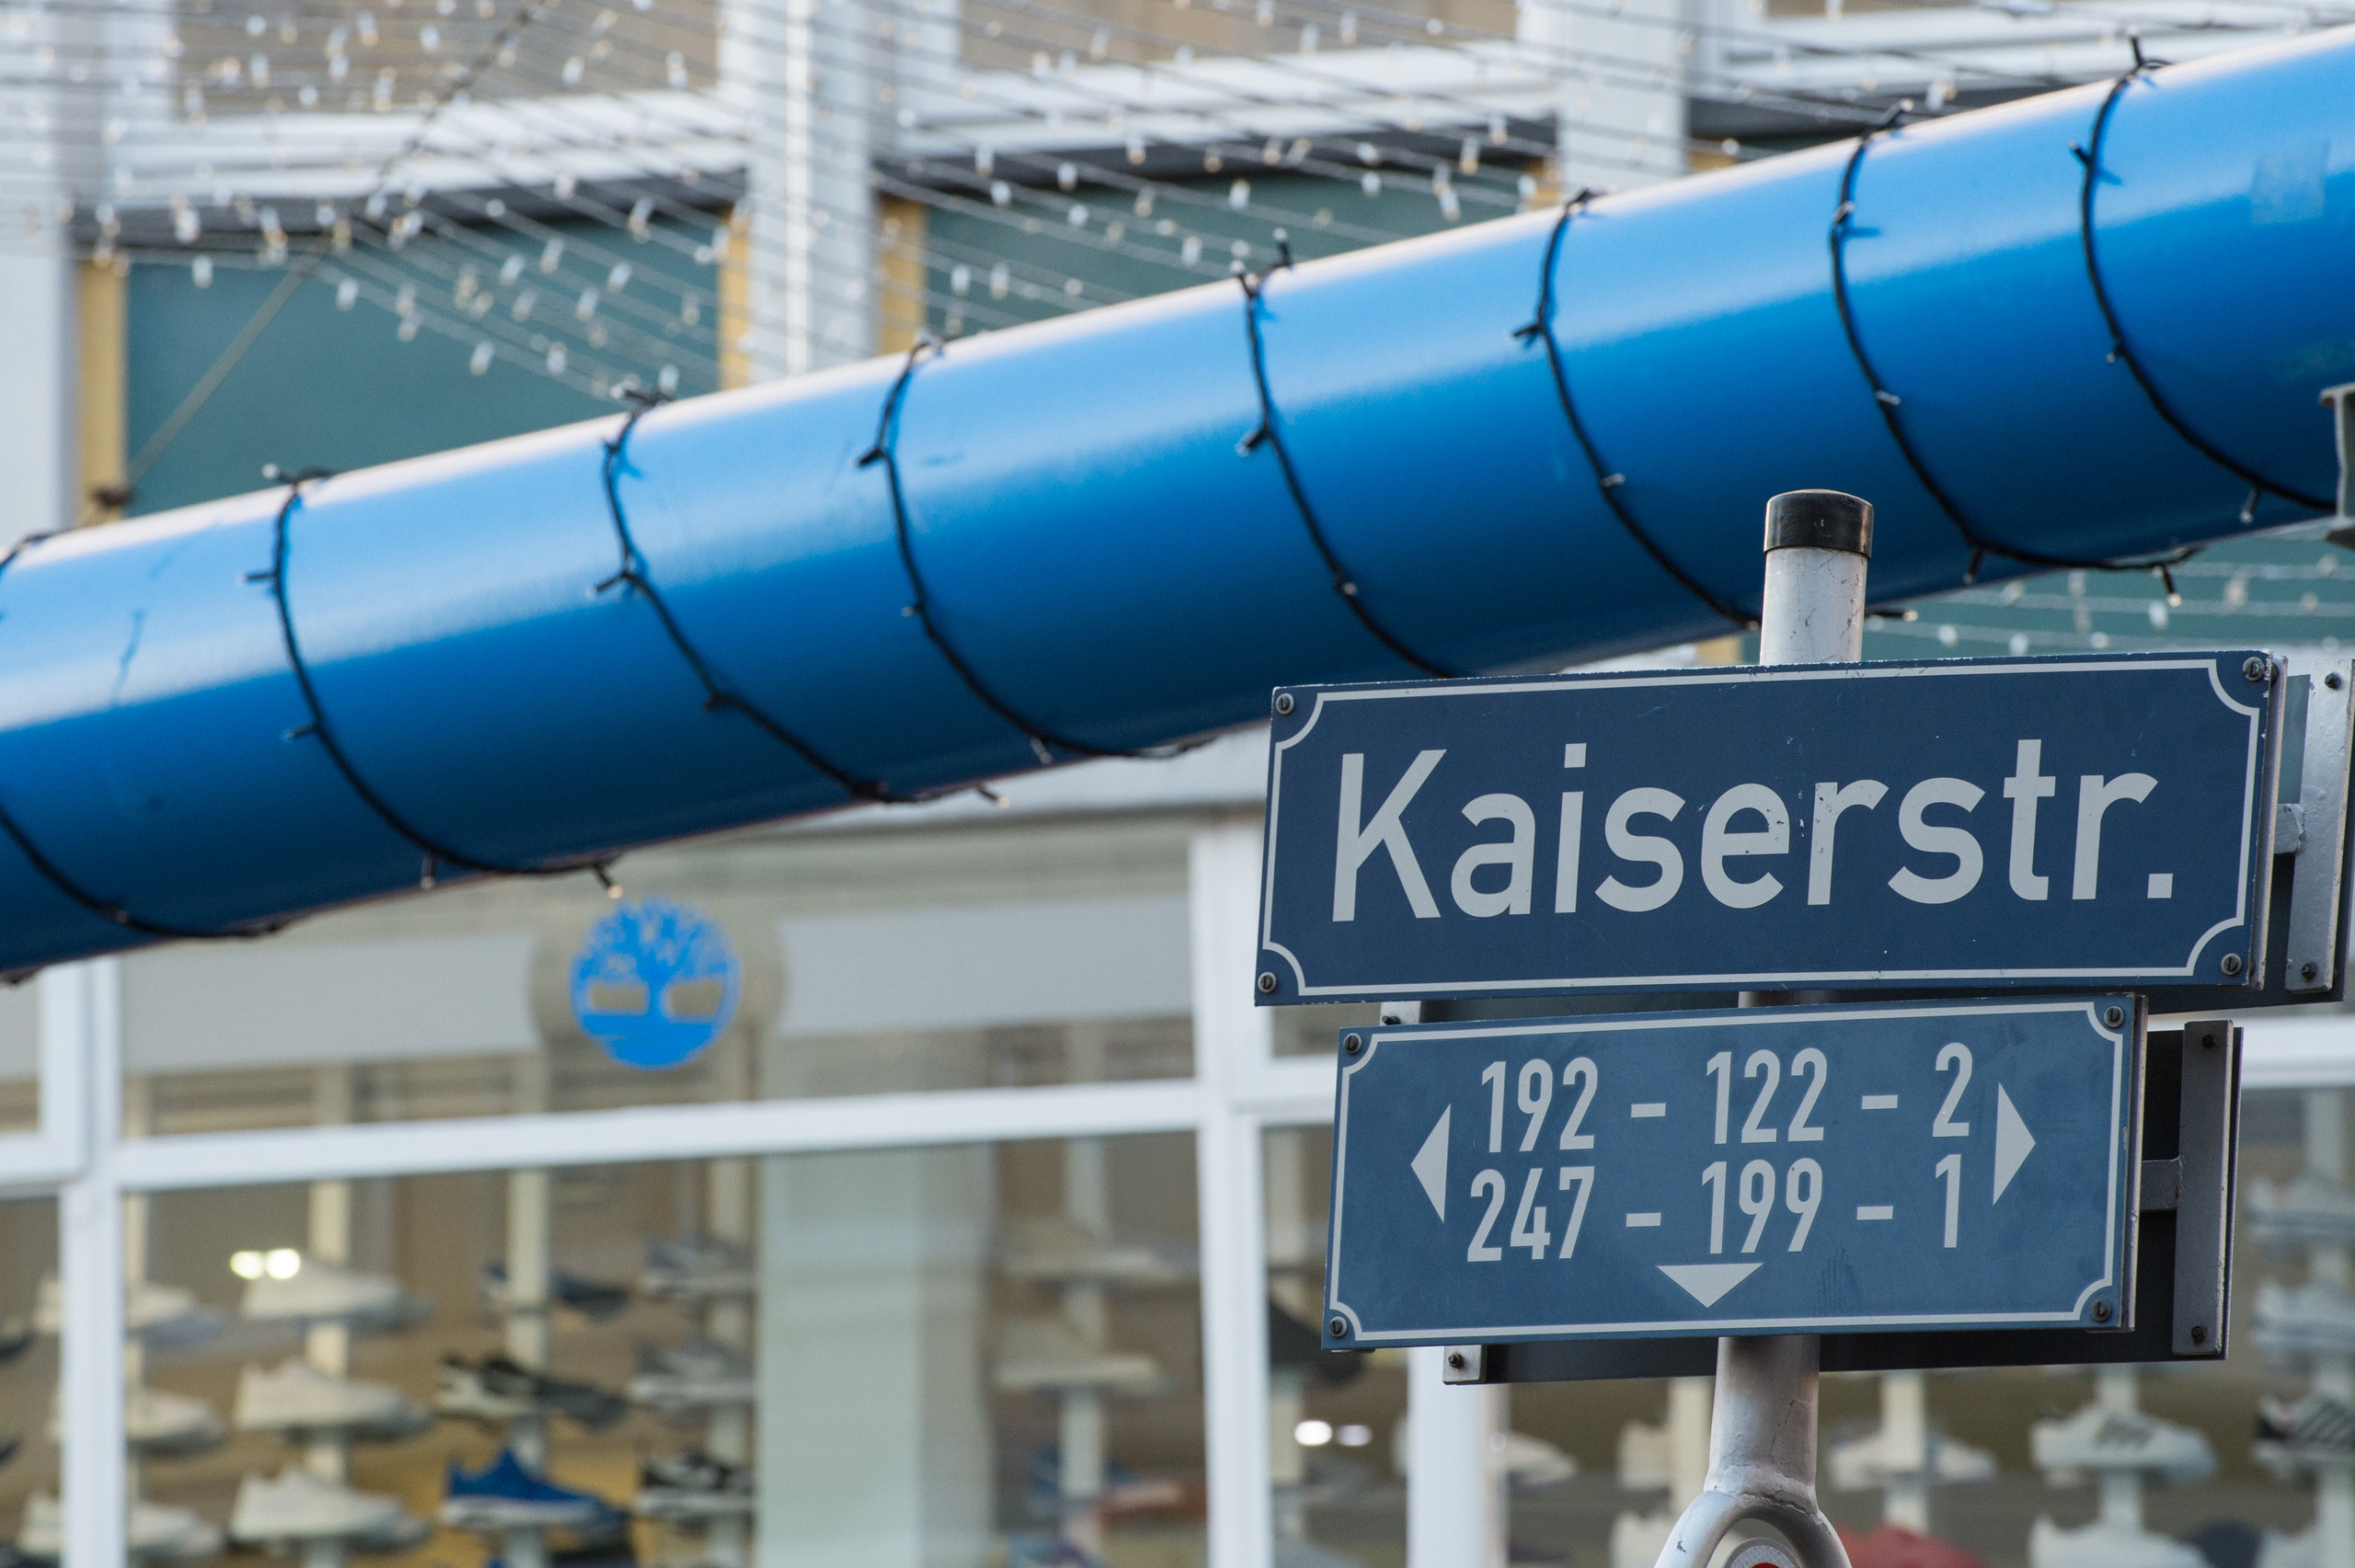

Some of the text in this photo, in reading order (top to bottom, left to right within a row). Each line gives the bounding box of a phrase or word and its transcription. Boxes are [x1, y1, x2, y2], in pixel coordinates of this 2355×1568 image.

[1331, 738, 2175, 923] Kaiserstr.
[1480, 1056, 1599, 1154] 192
[1706, 1047, 1829, 1146] 122
[1932, 1041, 1974, 1139] 2
[1466, 1164, 1596, 1263] 247
[1701, 1157, 1824, 1255] 199
[1934, 1152, 1962, 1249] 1
